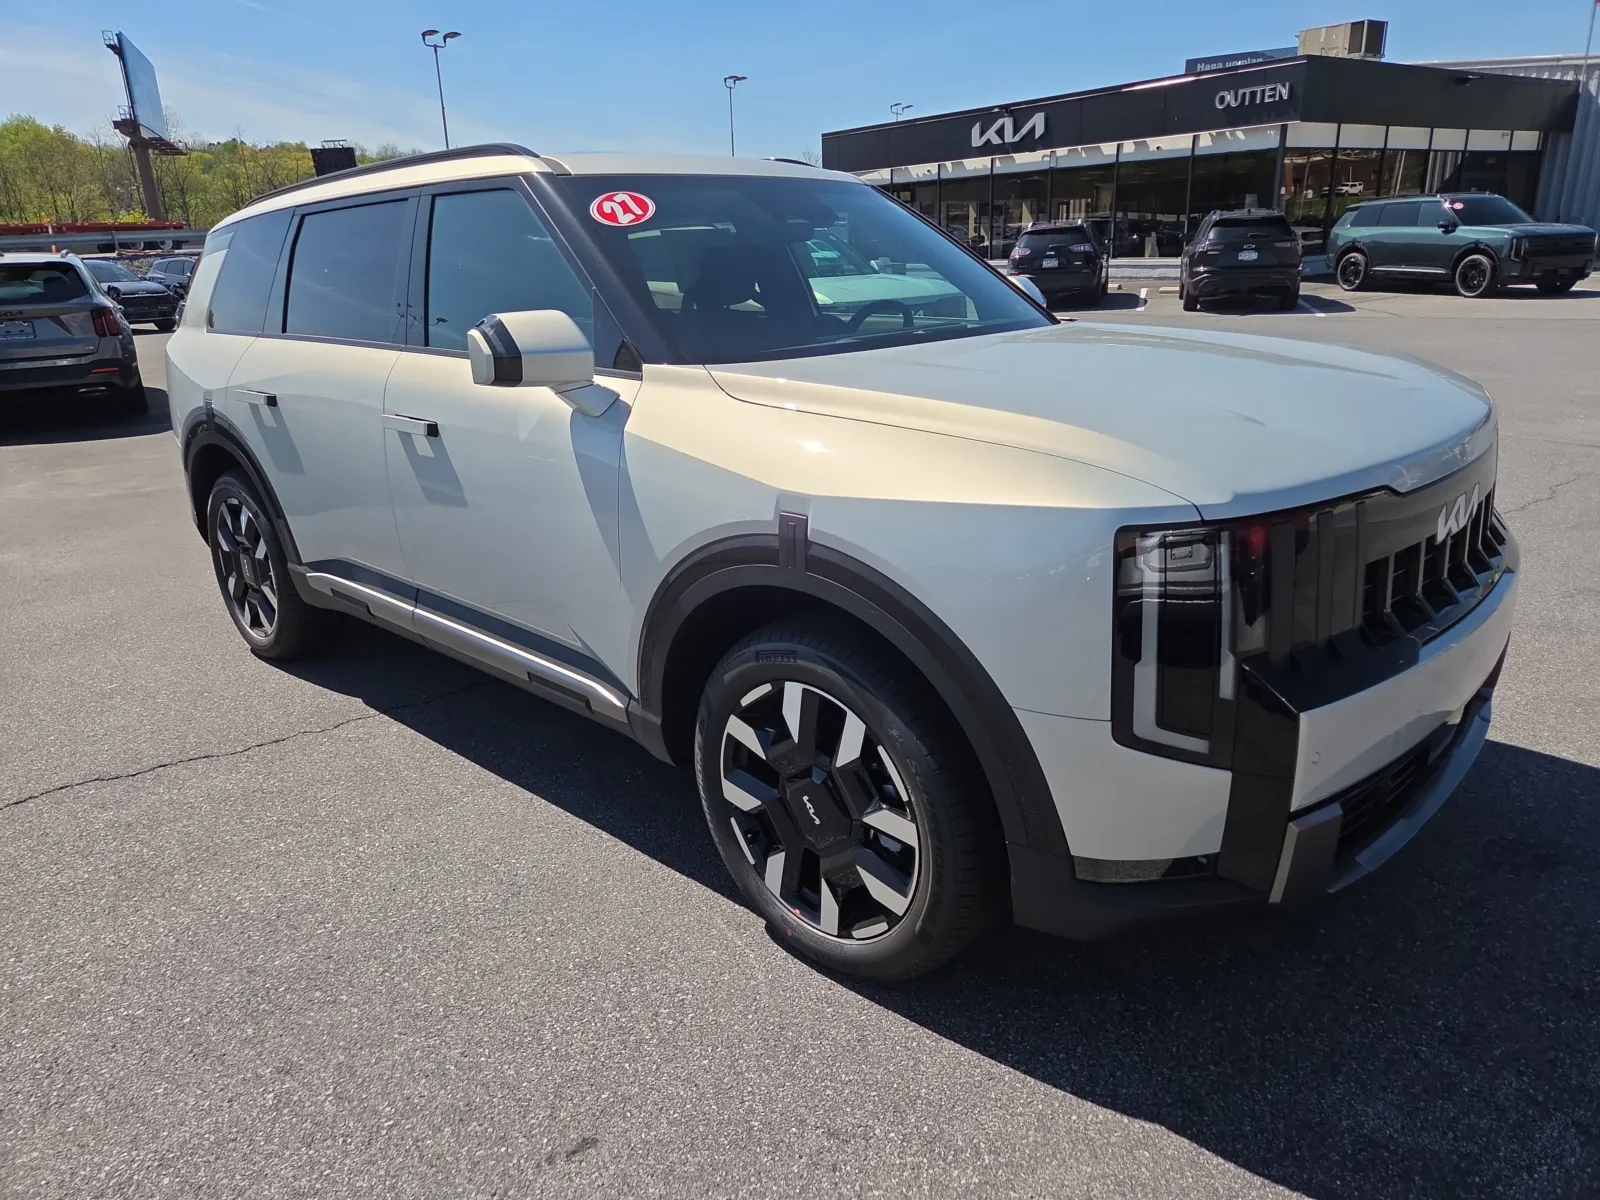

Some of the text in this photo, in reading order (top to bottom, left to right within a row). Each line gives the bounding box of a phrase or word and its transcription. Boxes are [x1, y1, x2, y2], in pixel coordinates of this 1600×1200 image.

[1197, 62, 1223, 72] Haga
[1215, 82, 1290, 109] OUTTEN
[972, 112, 1045, 148] KIA
[1436, 483, 1480, 545] KIA
